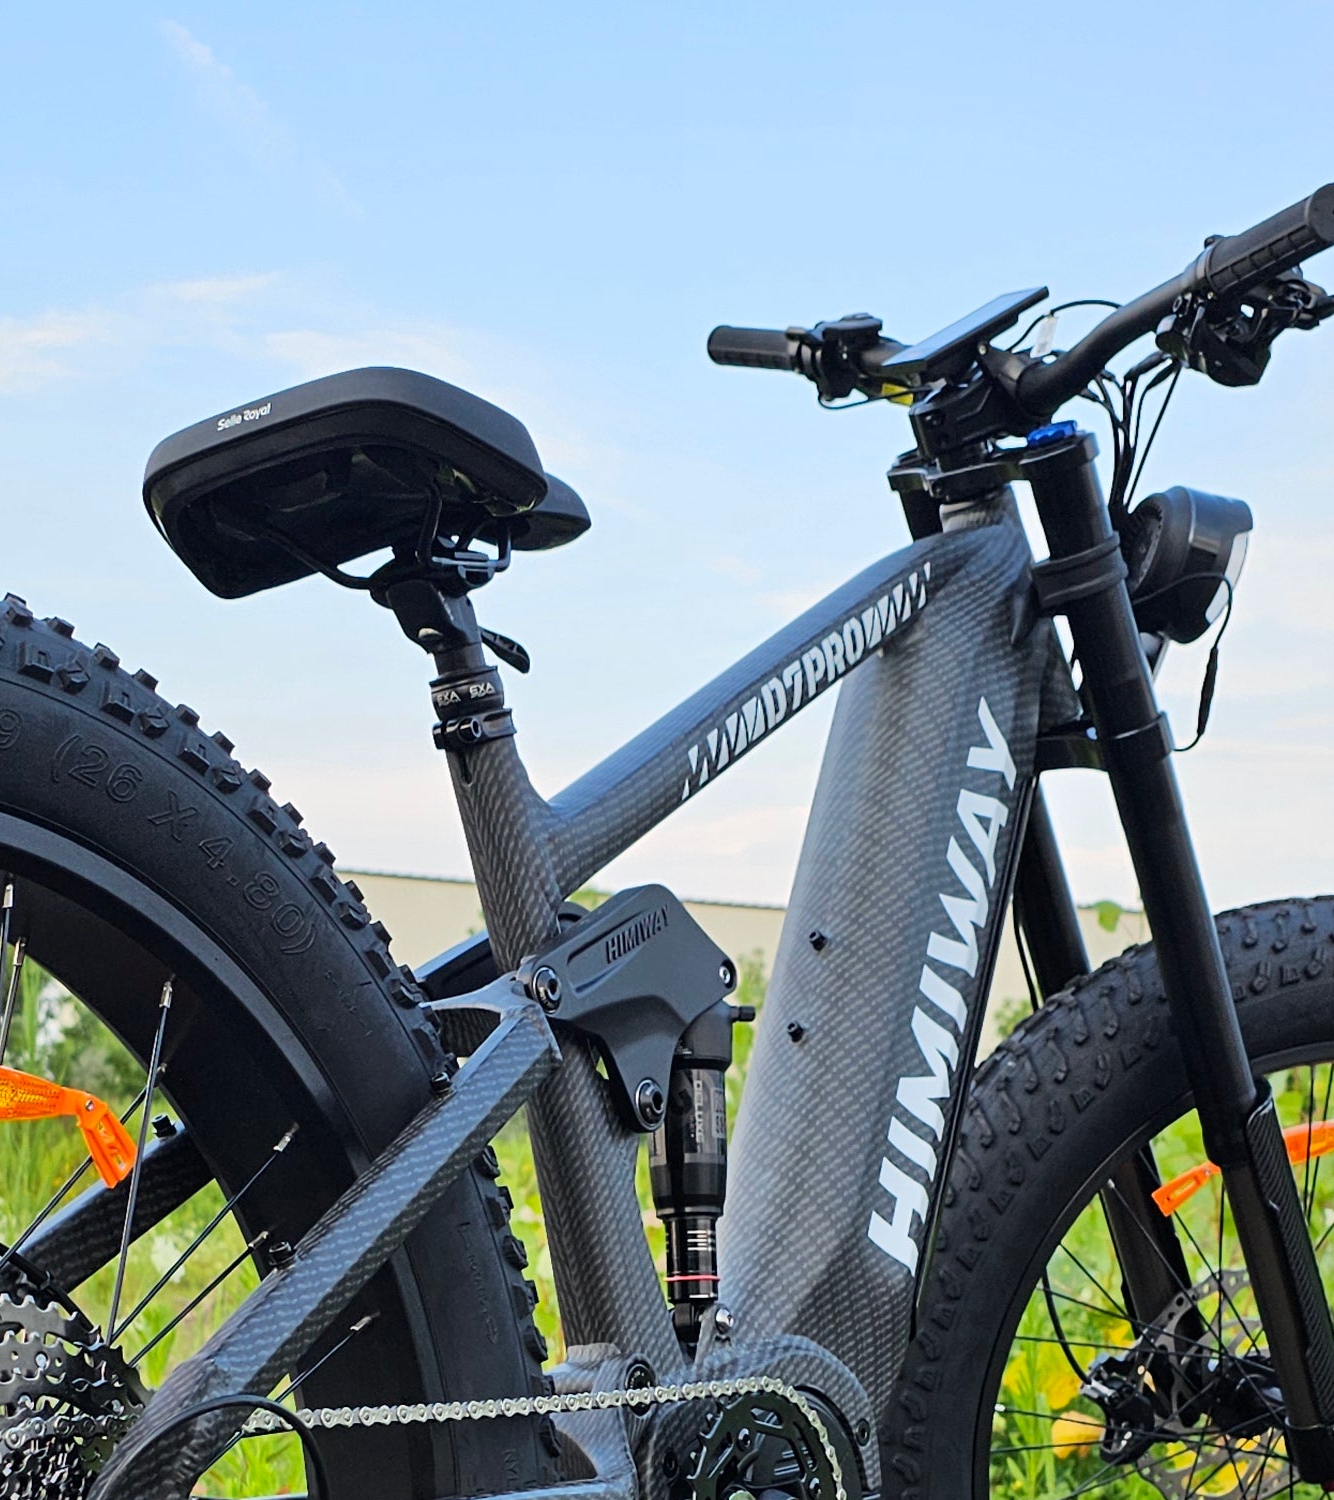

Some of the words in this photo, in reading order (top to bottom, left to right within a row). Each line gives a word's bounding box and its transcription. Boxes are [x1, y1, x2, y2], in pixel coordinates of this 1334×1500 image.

[217, 414, 243, 432] Selle
[243, 402, 272, 421] Royal
[469, 682, 497, 698] EXA
[605, 903, 669, 965] HIMIWAY
[868, 696, 1017, 1277] HIMIWAY
